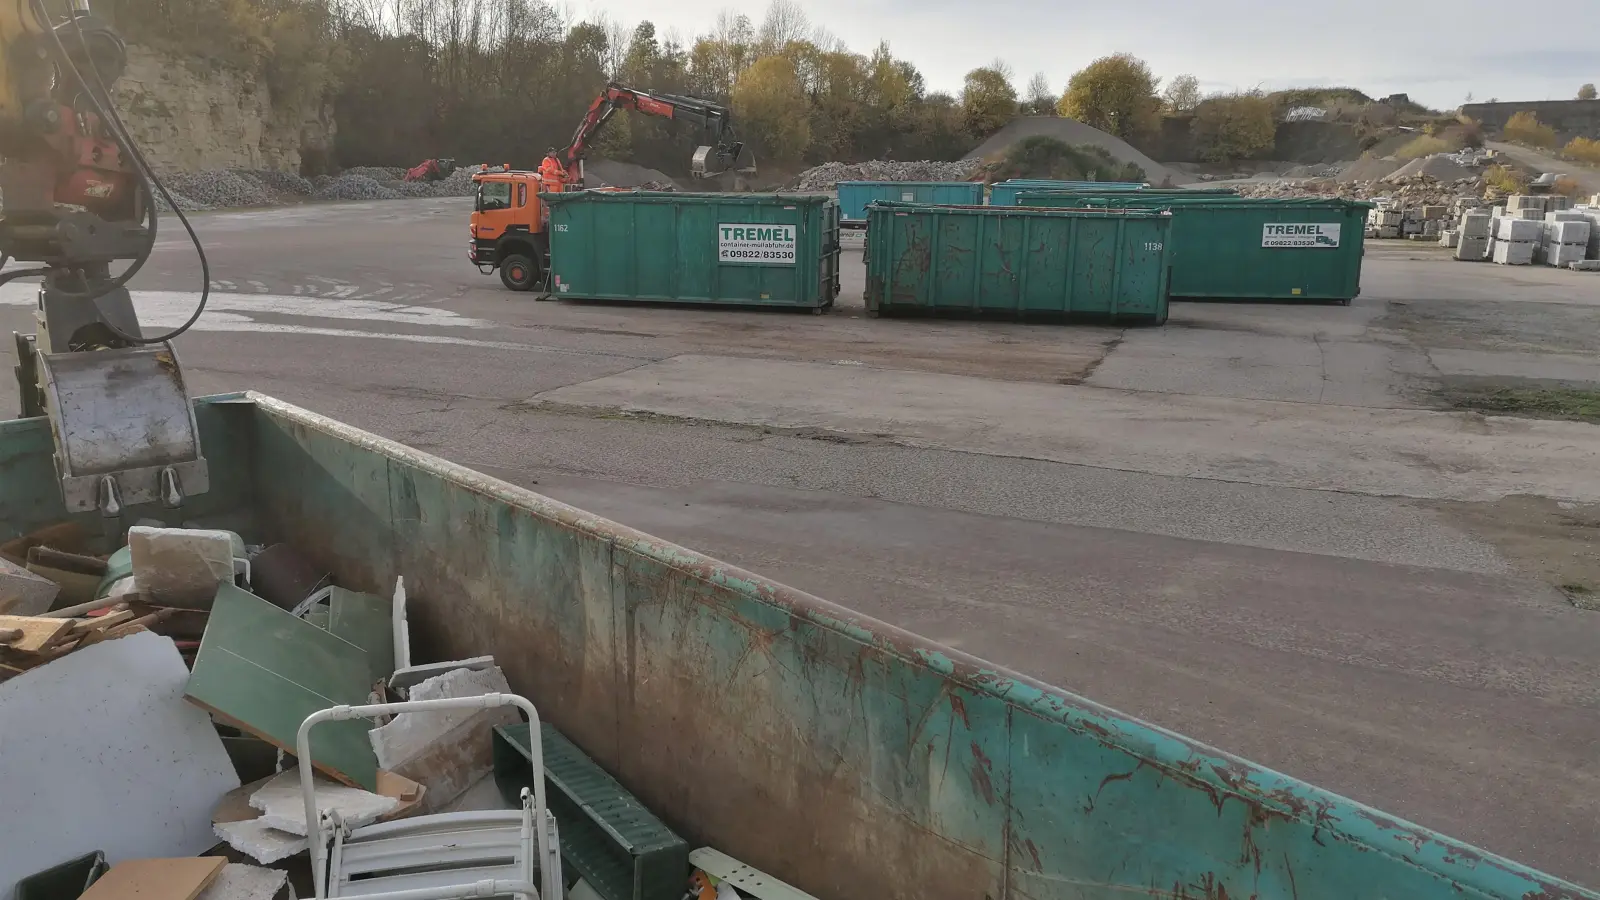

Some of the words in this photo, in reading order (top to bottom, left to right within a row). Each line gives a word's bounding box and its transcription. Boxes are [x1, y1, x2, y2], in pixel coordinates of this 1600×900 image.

[553, 224, 569, 232] 1162
[1265, 225, 1324, 235] TREMEL
[720, 227, 794, 242] TREMEL
[1144, 242, 1163, 251] 1138
[730, 250, 794, 259] 09822/83530
